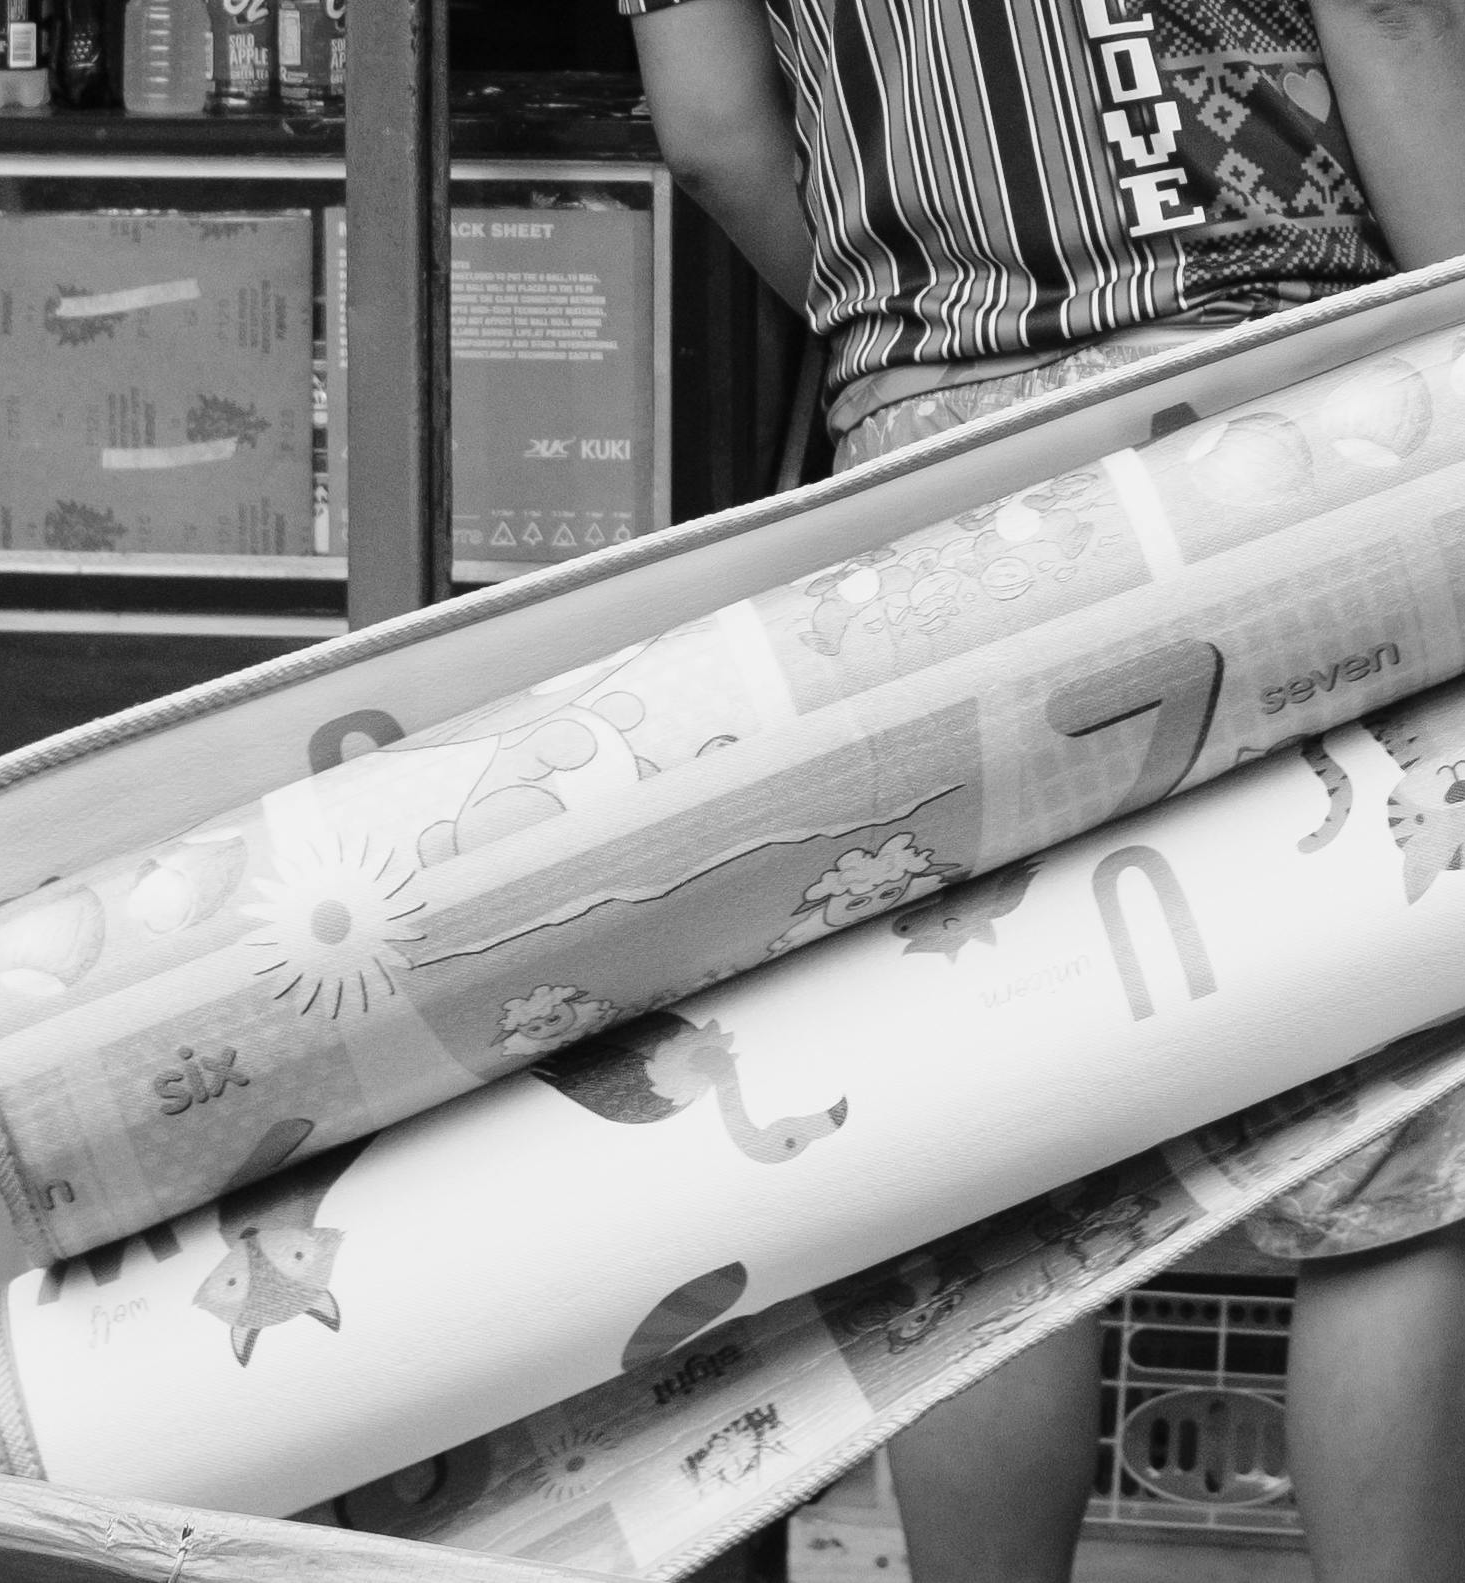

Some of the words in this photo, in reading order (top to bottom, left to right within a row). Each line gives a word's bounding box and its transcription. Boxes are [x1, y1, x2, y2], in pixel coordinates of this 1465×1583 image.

[227, 33, 256, 47] SOLO
[227, 47, 270, 66] APPLE
[490, 222, 555, 239] SHEET
[580, 438, 631, 460] KUKI
[1258, 637, 1402, 716] seven
[1091, 843, 1219, 1023] U
[978, 954, 1092, 1010] unicorn
[152, 1044, 251, 1117] six
